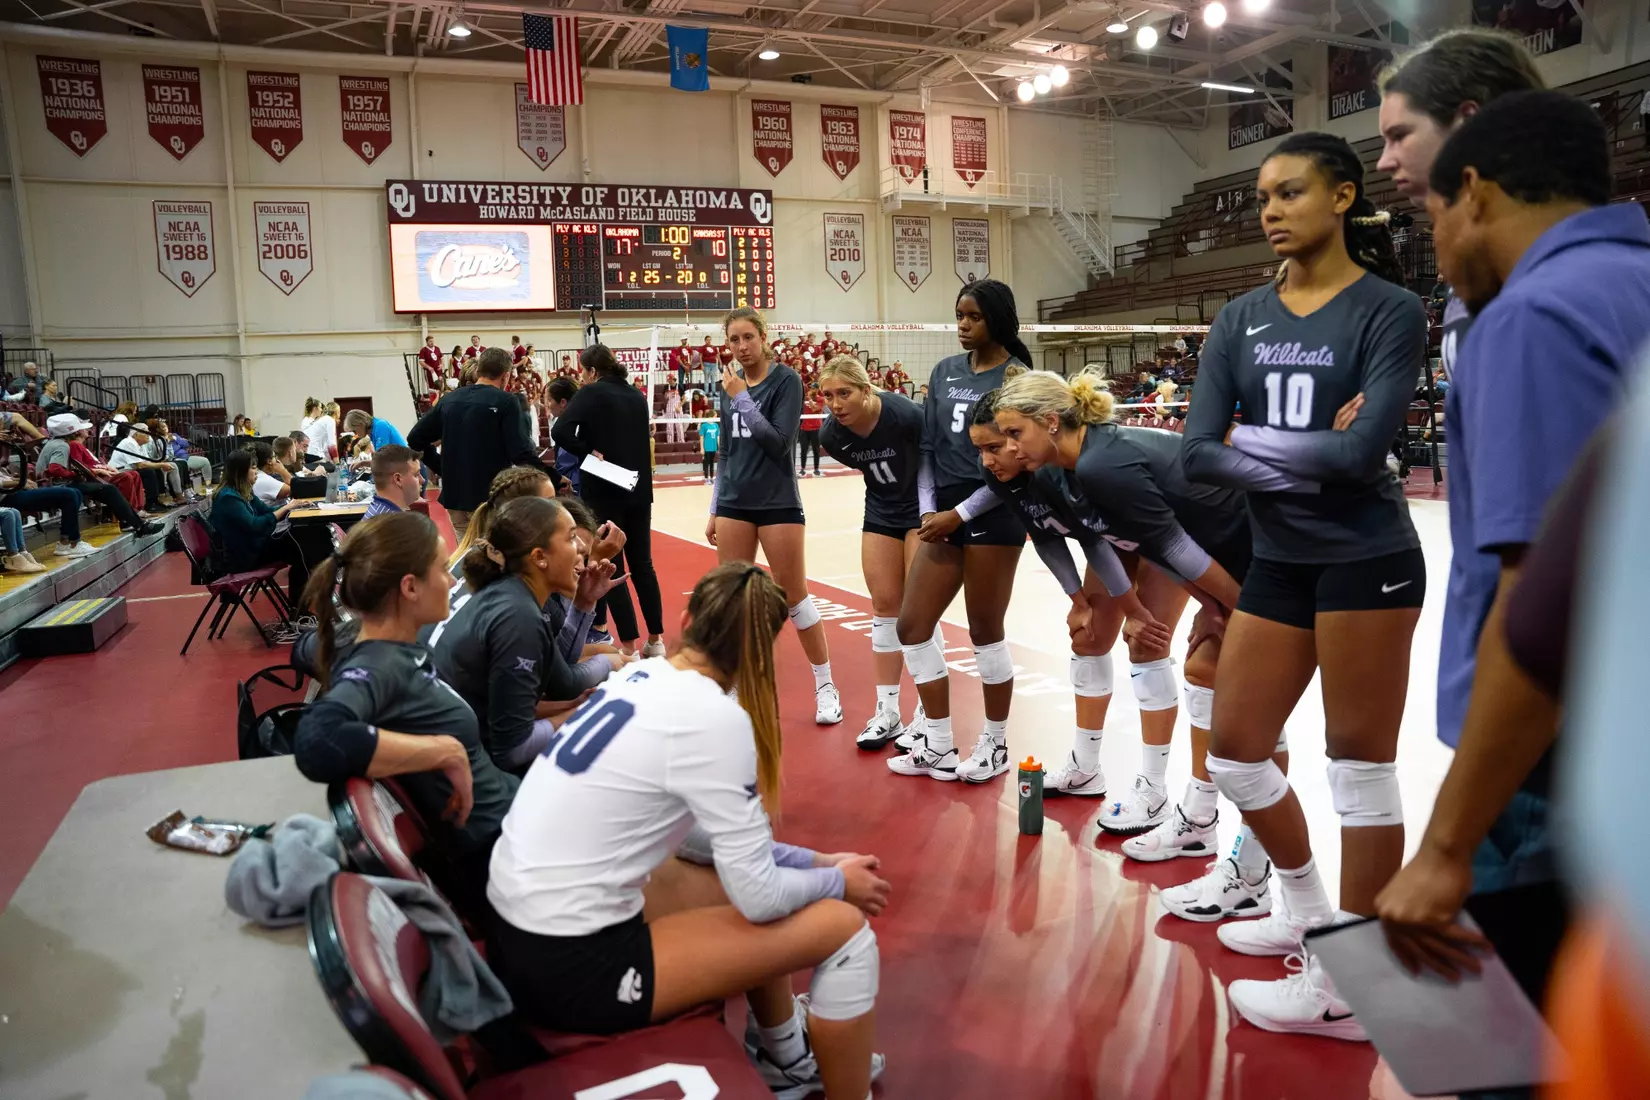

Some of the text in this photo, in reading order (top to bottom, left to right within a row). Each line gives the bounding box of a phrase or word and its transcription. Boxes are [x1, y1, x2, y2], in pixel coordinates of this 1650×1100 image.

[40, 59, 98, 74] WRESTLING
[145, 68, 198, 80] WRESTLING
[249, 75, 298, 86] WRESTLING
[341, 80, 388, 90] WRESTLING
[48, 78, 95, 97] 1936
[152, 86, 190, 102] 1951
[256, 91, 294, 107] 1952
[45, 96, 103, 110] NATIONAL
[148, 102, 201, 115] NATIONAL
[348, 96, 382, 110] 1957
[753, 102, 790, 112] WRESTLING
[1332, 90, 1366, 116] DRAKE
[46, 108, 104, 120] CHAMPIONS
[251, 108, 300, 118] NATIONAL
[519, 104, 562, 114] CHAMPIONS
[822, 108, 858, 118] WRESTLING
[150, 114, 201, 125] CHAMPIONS
[343, 111, 390, 122] NATIONAL
[891, 113, 924, 123] WRESTLING
[252, 118, 300, 128] CHAMPIONS
[344, 122, 390, 132] CHAMPIONS
[758, 116, 787, 130] 1960
[826, 121, 854, 134] 1963
[953, 120, 984, 128] WRESTLING
[754, 130, 791, 140] NATIONAL
[895, 126, 920, 139] 1974
[954, 134, 986, 142] CHAMPIONS
[1231, 123, 1264, 148] CONNER
[755, 140, 792, 148] CHAMPIONS
[823, 134, 858, 144] NATIONAL
[892, 139, 925, 150] NATIONAL
[824, 144, 859, 152] CHAMPIONS
[892, 148, 925, 158] CHAMPIONS
[388, 184, 416, 218] OU
[422, 184, 744, 210] UNIVERSITY OF OKLAHOMA
[158, 204, 208, 214] VOLLEYBALL
[258, 206, 306, 214] VOLLEYBALL
[750, 192, 772, 224] OU
[480, 206, 696, 222] HOWARD McCASLAND FIELD HOUSE
[827, 216, 861, 224] VOLLEYBALL
[168, 222, 200, 232] NCAA
[268, 222, 298, 232] NCAA
[556, 225, 597, 233] PLY AC KLS
[606, 228, 639, 236] OKLAHOMA
[902, 228, 922, 236] NCAA
[164, 233, 206, 242] SWEET 16
[264, 232, 304, 241] SWEET 16
[662, 227, 688, 244] 1:00
[834, 230, 856, 239] NCAA
[617, 238, 631, 254] 17
[712, 240, 726, 256] 10
[738, 238, 772, 247] 2 2 5
[164, 244, 208, 260] 1988
[262, 244, 308, 260] 2006
[672, 247, 680, 260] 2
[740, 250, 772, 260] 3 0 0
[830, 248, 860, 262] 2010
[431, 244, 520, 288] Cane's
[739, 262, 772, 272] 4 0 2
[644, 270, 660, 284] 25
[677, 271, 692, 284] 20
[720, 271, 728, 284] 0
[737, 274, 773, 283] 12 1 0
[738, 286, 774, 295] 14 0 2
[738, 298, 774, 307] 15 0 0
[1254, 342, 1334, 366] Wildcats
[618, 361, 670, 372] ECTON
[947, 386, 985, 401] Wildca
[1265, 372, 1314, 428] 10
[950, 403, 970, 434] 5
[851, 448, 896, 462] Wildcats
[869, 461, 898, 484] 11
